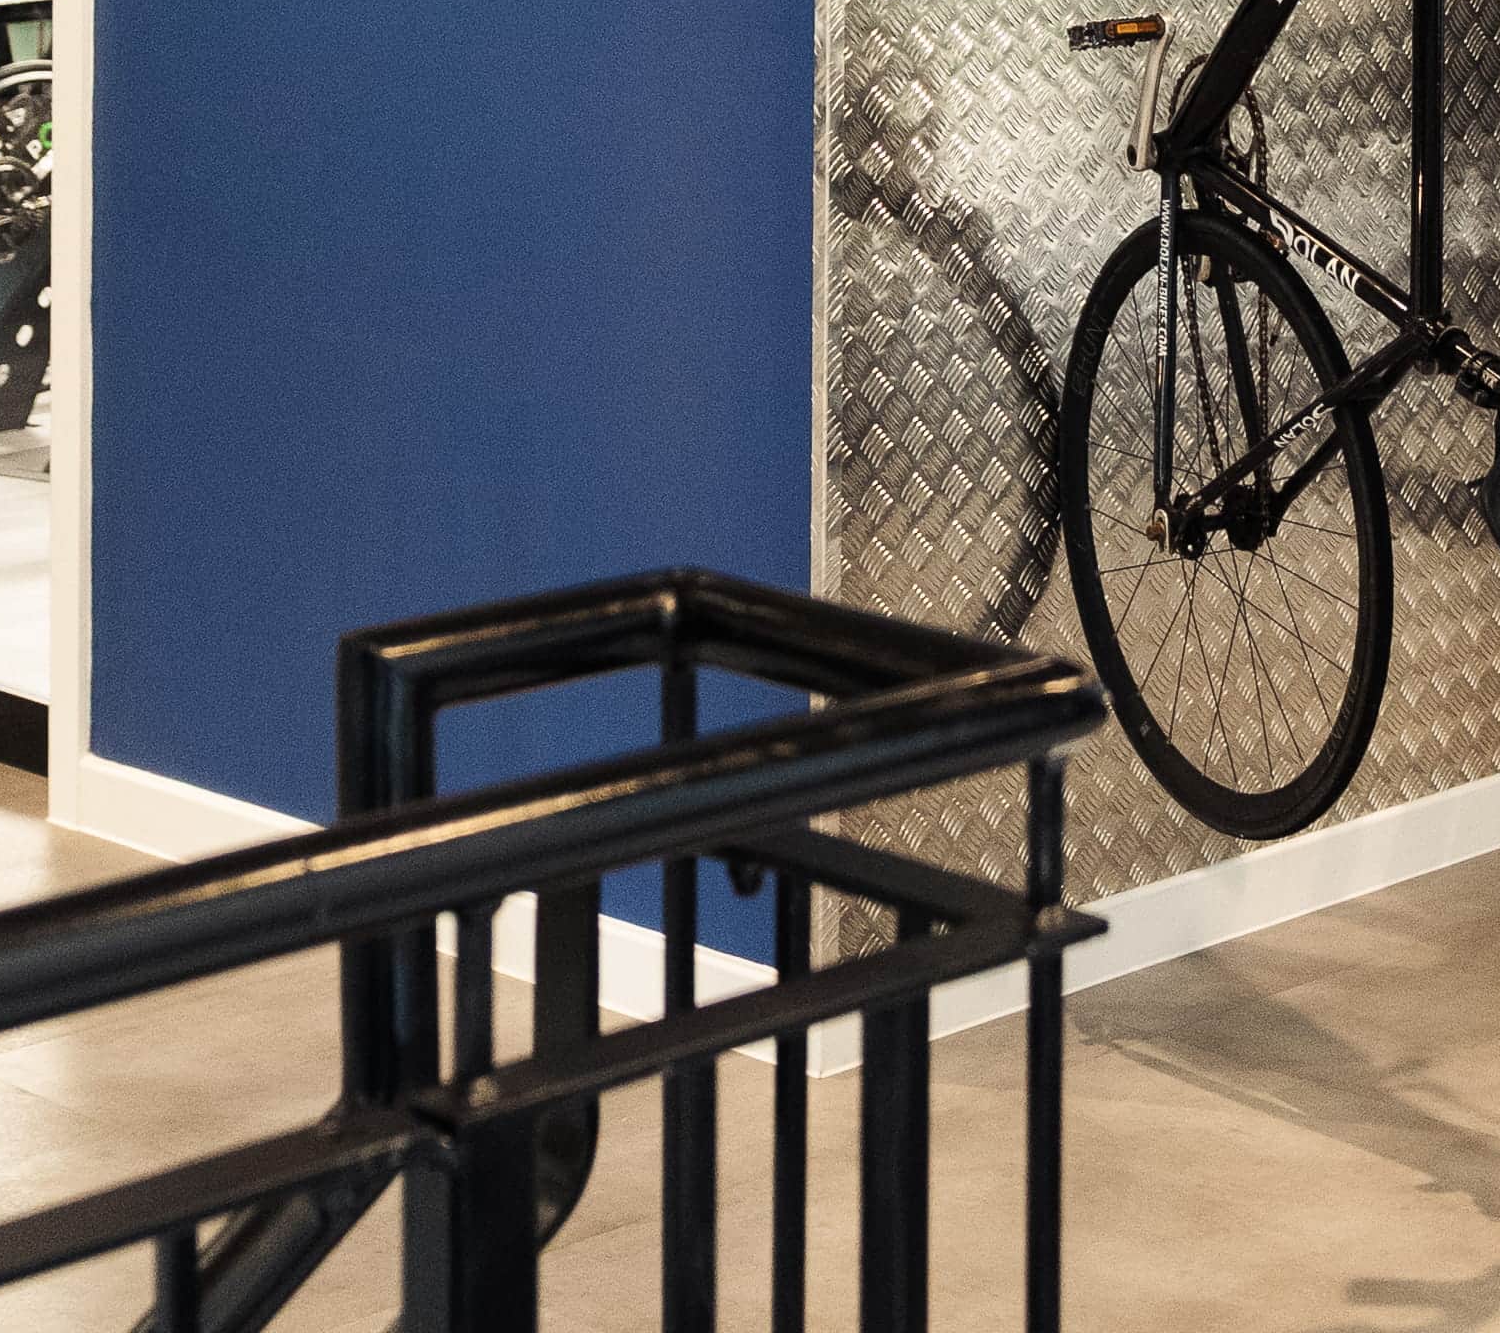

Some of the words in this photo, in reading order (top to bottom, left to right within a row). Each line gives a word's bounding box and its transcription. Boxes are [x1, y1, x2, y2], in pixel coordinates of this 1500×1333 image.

[1156, 199, 1171, 357] WWW.DOLAN-BIKES.COM
[1269, 208, 1361, 292] DOLAN
[1273, 403, 1337, 450] DOLAN
